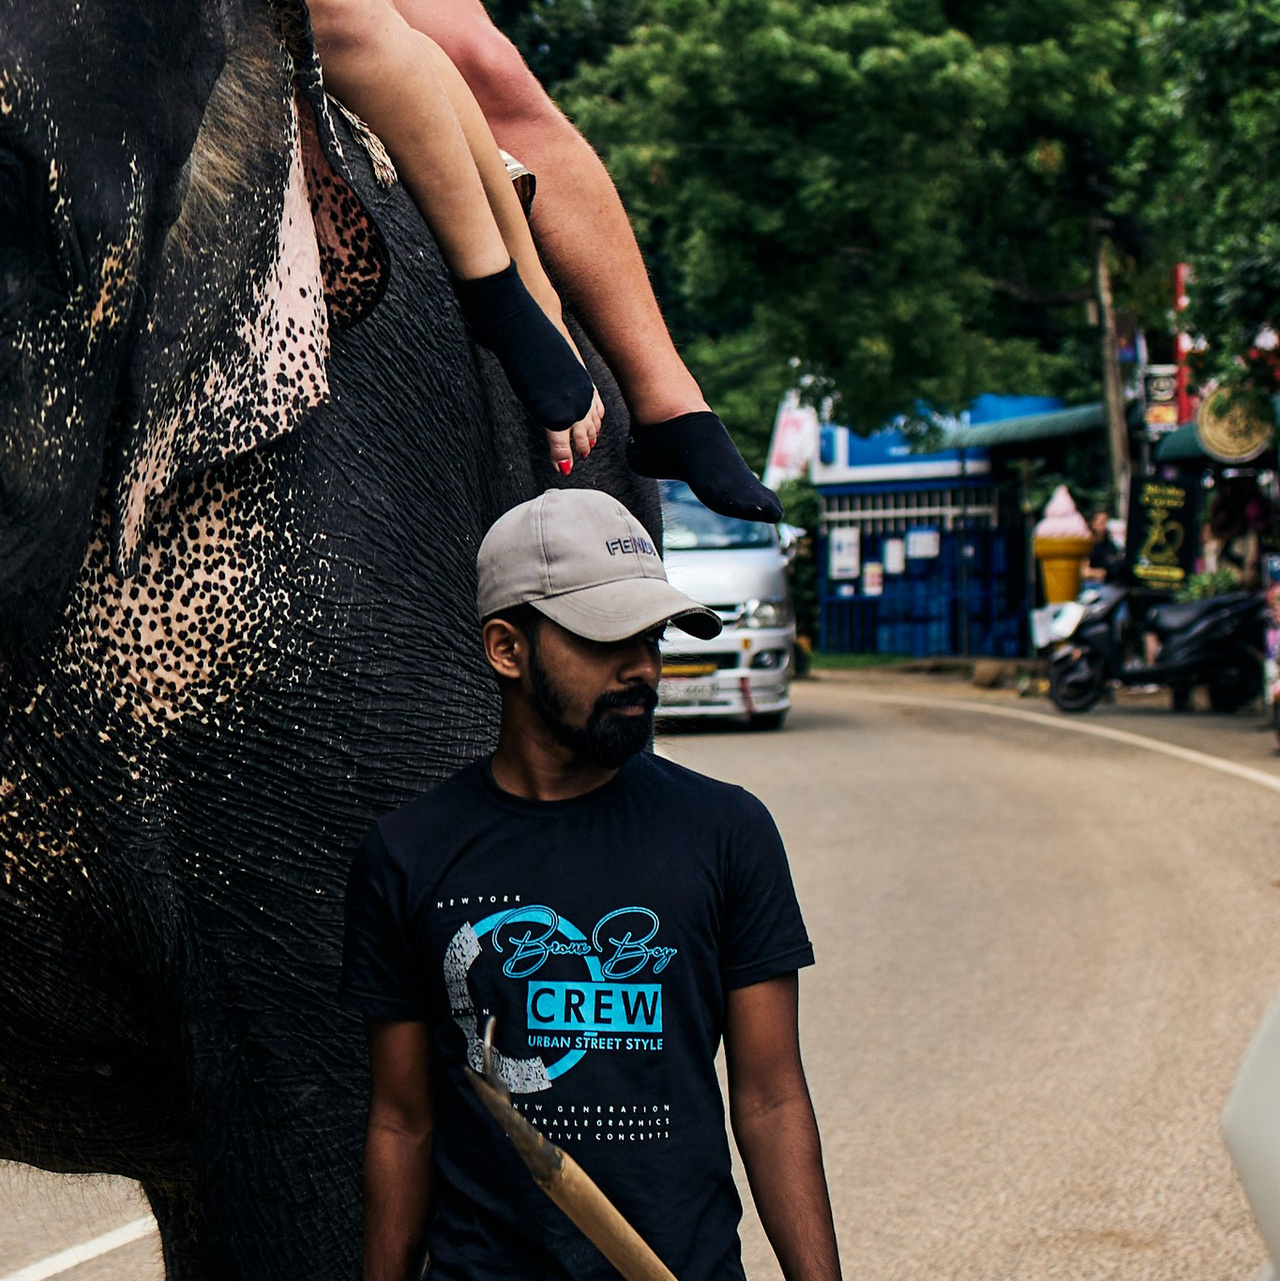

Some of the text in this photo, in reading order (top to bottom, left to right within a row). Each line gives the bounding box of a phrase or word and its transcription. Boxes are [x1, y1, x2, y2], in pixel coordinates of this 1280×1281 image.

[437, 894, 521, 909] NEW YORK
[592, 906, 677, 979] Boy
[530, 988, 659, 1025] CREW
[527, 1035, 663, 1051] URBAN STREET STYLE
[512, 1103, 670, 1114] NEW GENERATION
[523, 1117, 670, 1127] ARABLE GRAPHICS
[595, 1131, 669, 1141] CONCEPTS
